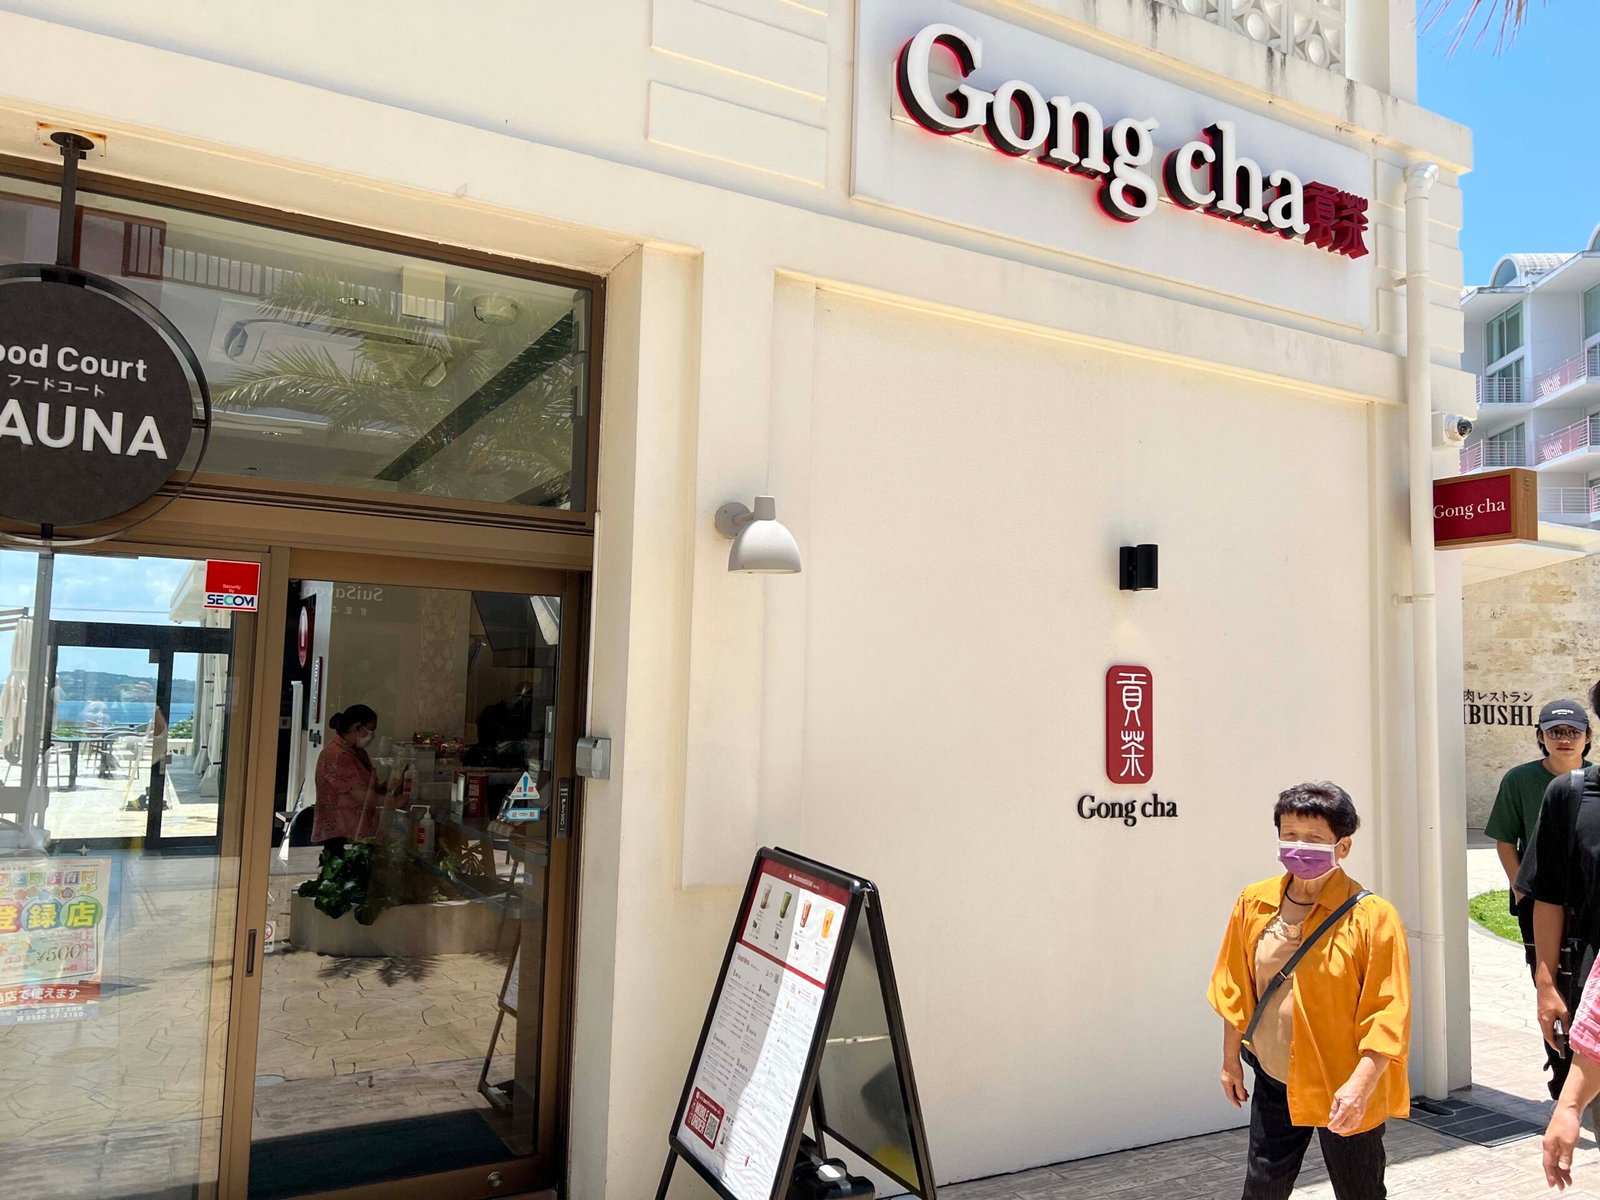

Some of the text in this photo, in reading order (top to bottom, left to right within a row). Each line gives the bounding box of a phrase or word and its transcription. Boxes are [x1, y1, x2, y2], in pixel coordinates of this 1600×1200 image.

[898, 22, 1310, 239] Gong cha
[0, 343, 148, 382] od Court
[8, 373, 105, 397] フードコート
[1433, 497, 1506, 520] Gong cha
[206, 593, 255, 607] SECOM
[1077, 793, 1178, 828] Gong cha
